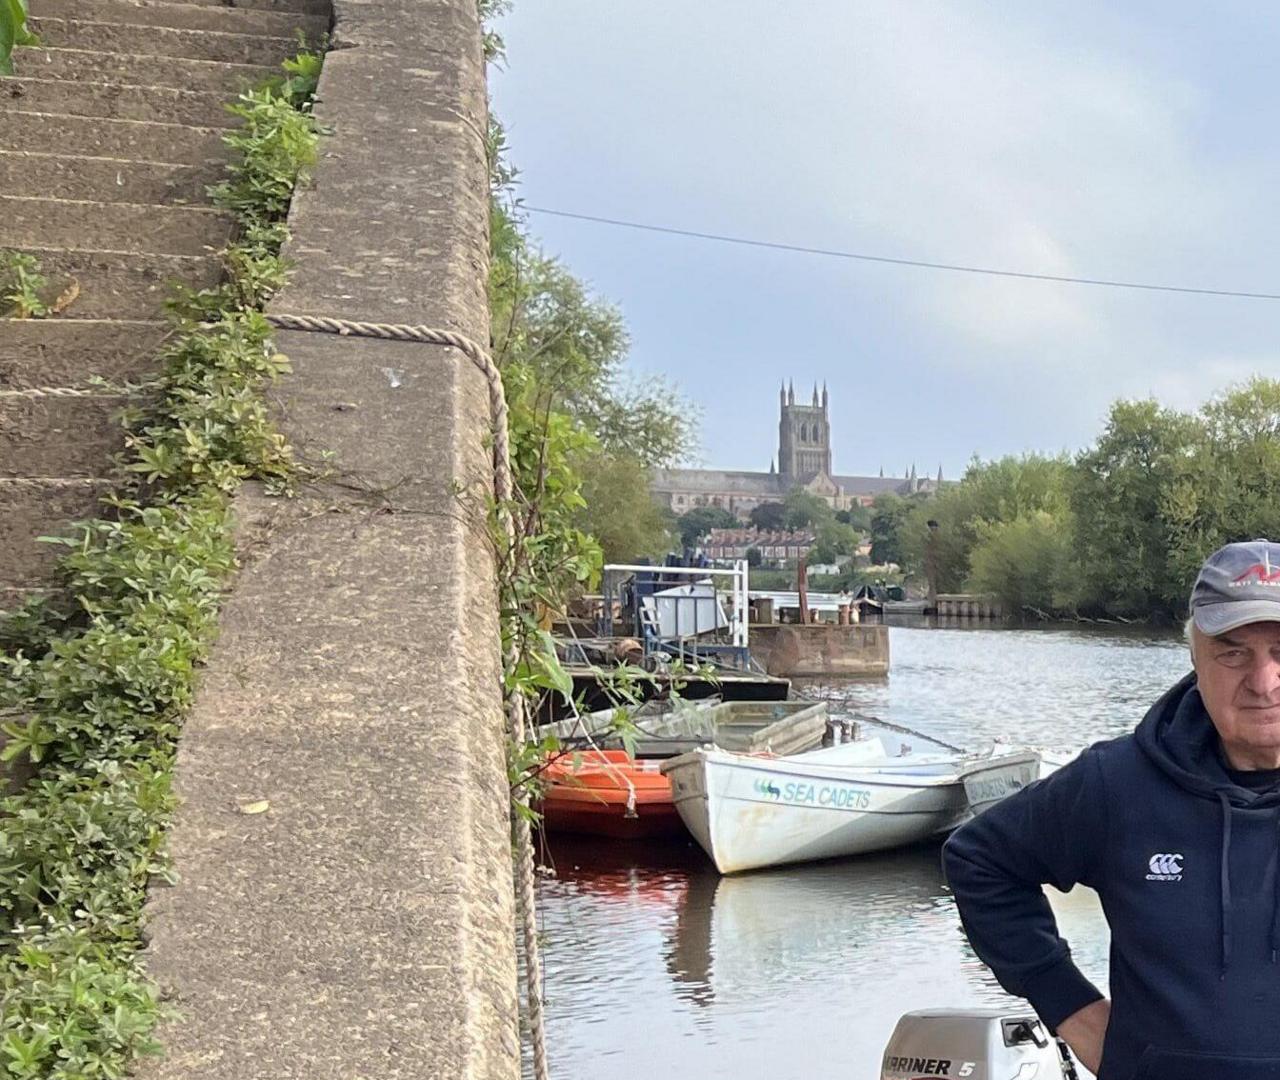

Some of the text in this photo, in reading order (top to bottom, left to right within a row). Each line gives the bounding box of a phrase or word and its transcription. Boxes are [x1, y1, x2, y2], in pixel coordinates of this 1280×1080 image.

[783, 783, 871, 809] SEA CADETS
[958, 1062, 976, 1077] 5
